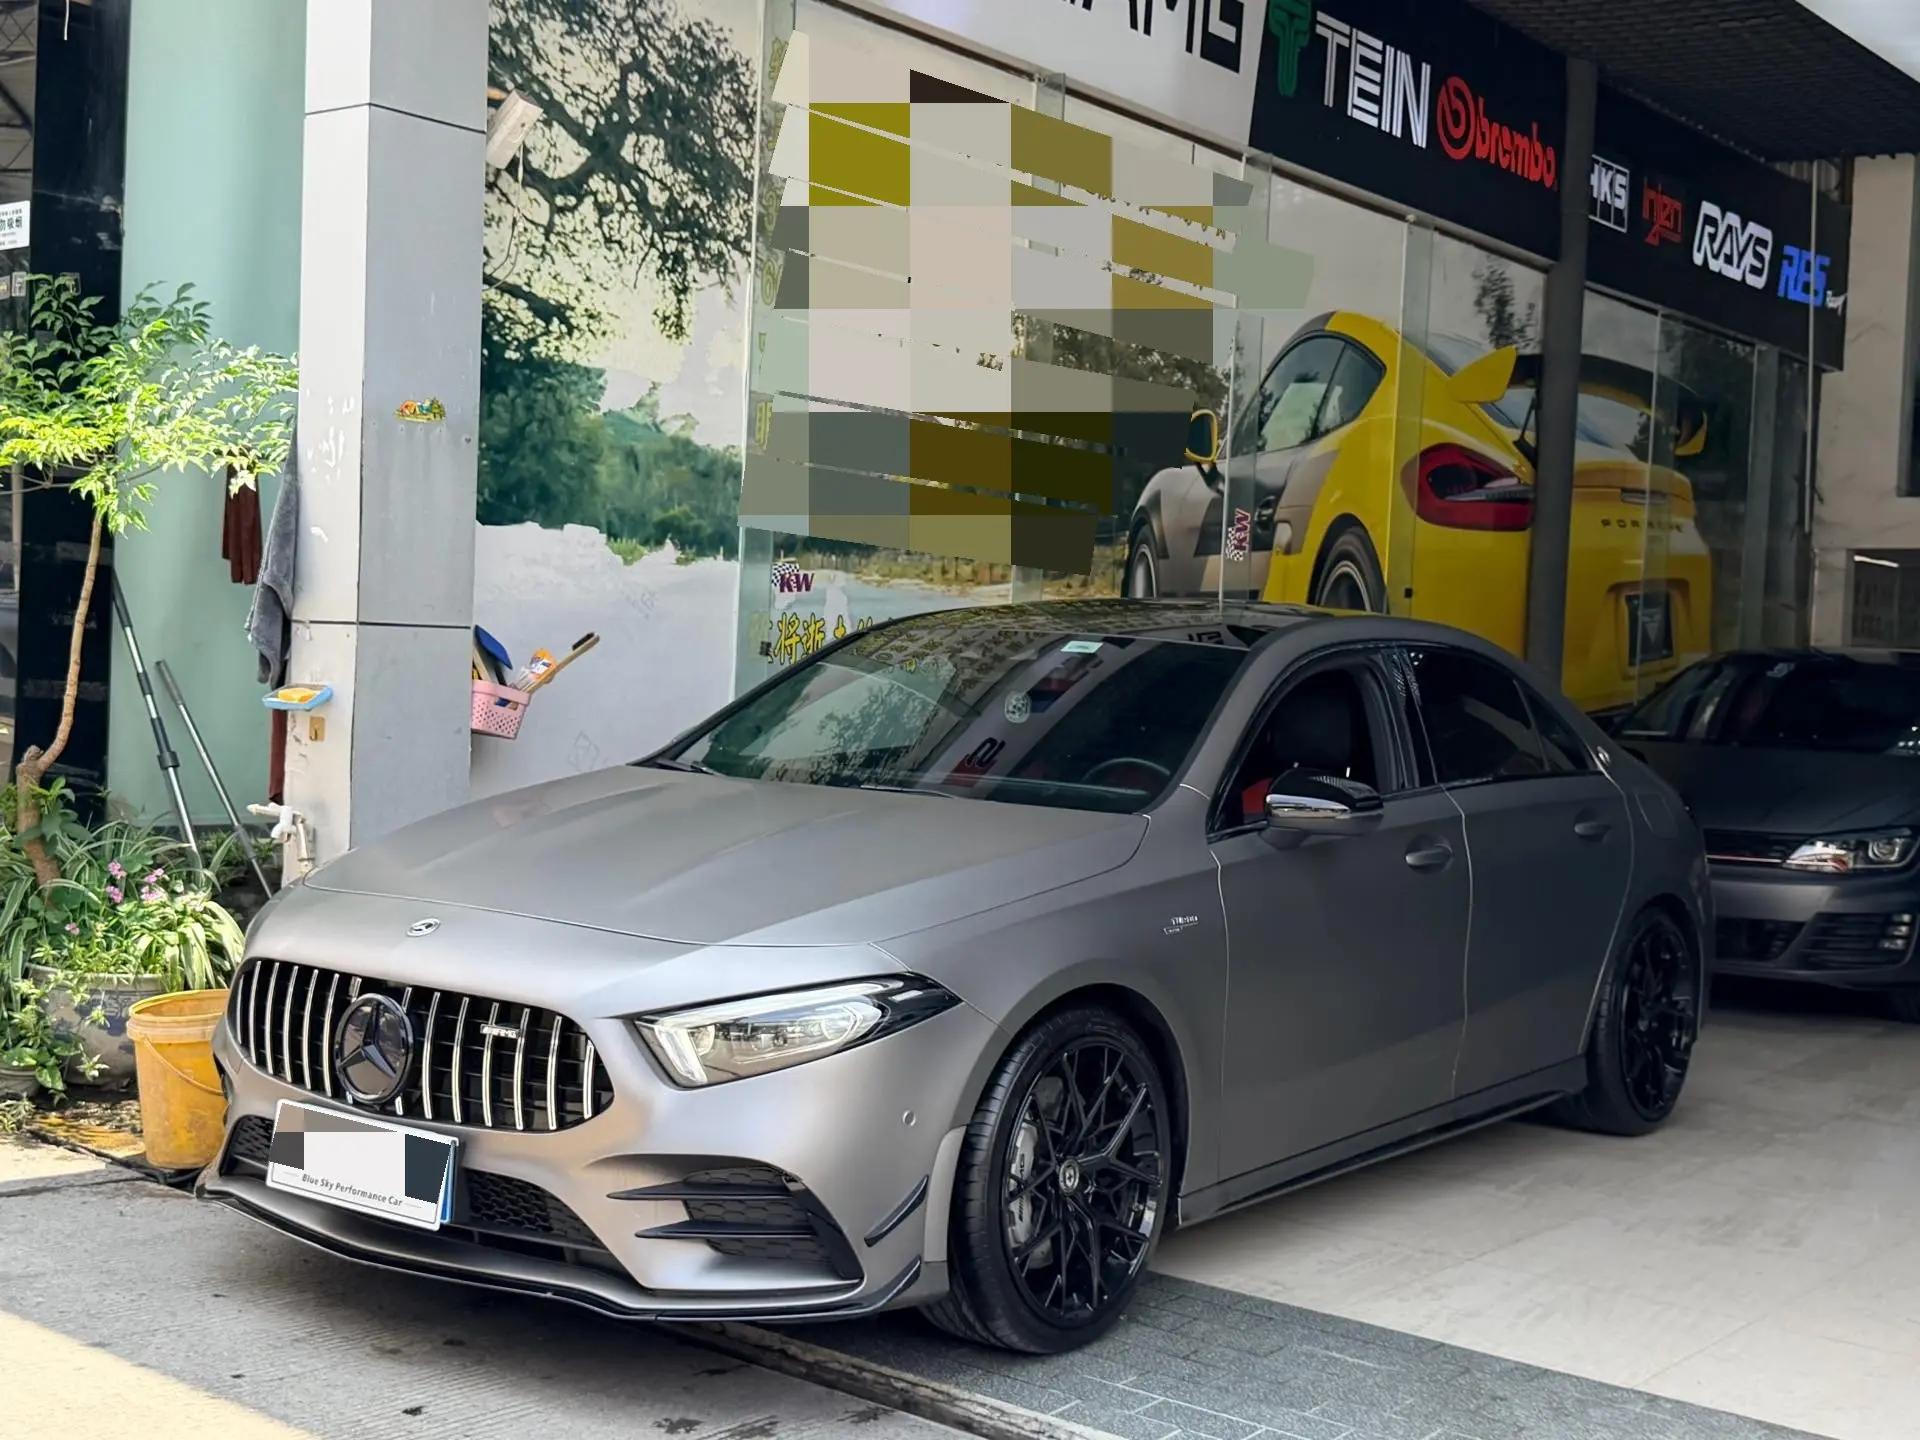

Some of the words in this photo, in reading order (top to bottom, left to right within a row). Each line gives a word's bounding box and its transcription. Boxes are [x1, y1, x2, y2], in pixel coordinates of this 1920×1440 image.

[1315, 10, 1431, 149] TEIN
[1474, 96, 1558, 189] brembo
[1693, 200, 1773, 290] RAYS
[779, 572, 815, 594] KW
[302, 1173, 319, 1186] Blue
[320, 1178, 334, 1191] Sky
[335, 1182, 387, 1203] Performance
[388, 1195, 403, 1207] Car
